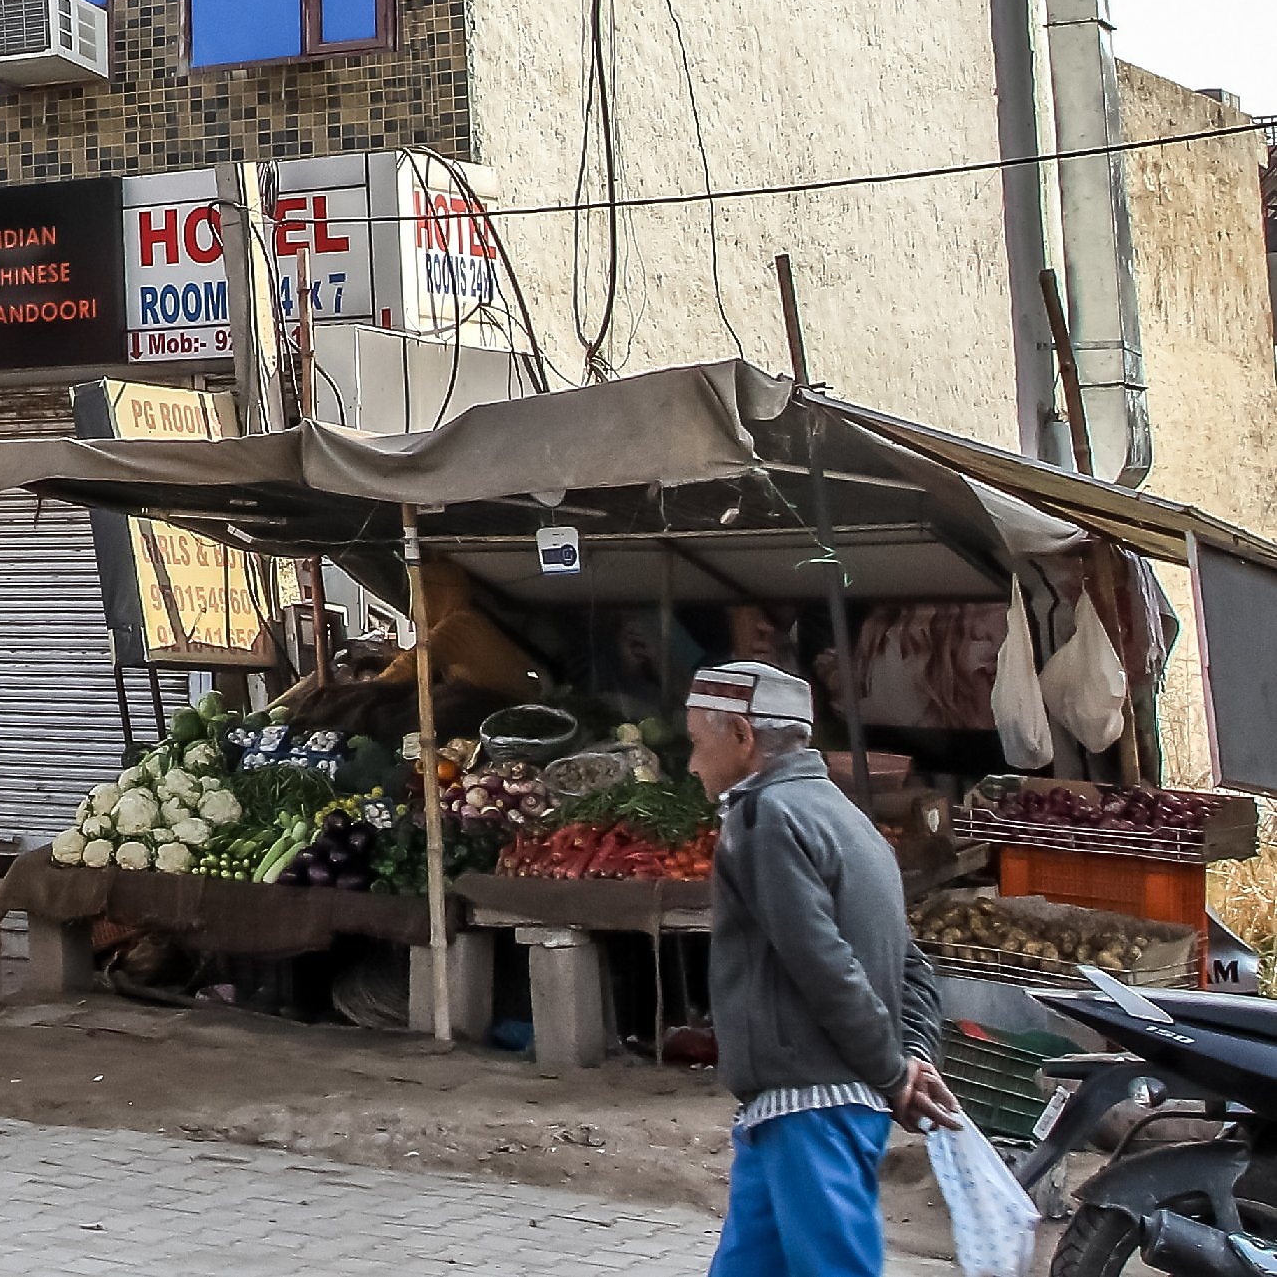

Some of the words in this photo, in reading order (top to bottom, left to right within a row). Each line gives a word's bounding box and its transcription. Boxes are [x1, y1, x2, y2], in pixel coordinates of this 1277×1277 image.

[138, 195, 350, 268] HOEL
[413, 190, 497, 261] HOTEL
[140, 285, 230, 326] ROOM
[131, 399, 156, 430] PG
[139, 534, 191, 567] GRLS
